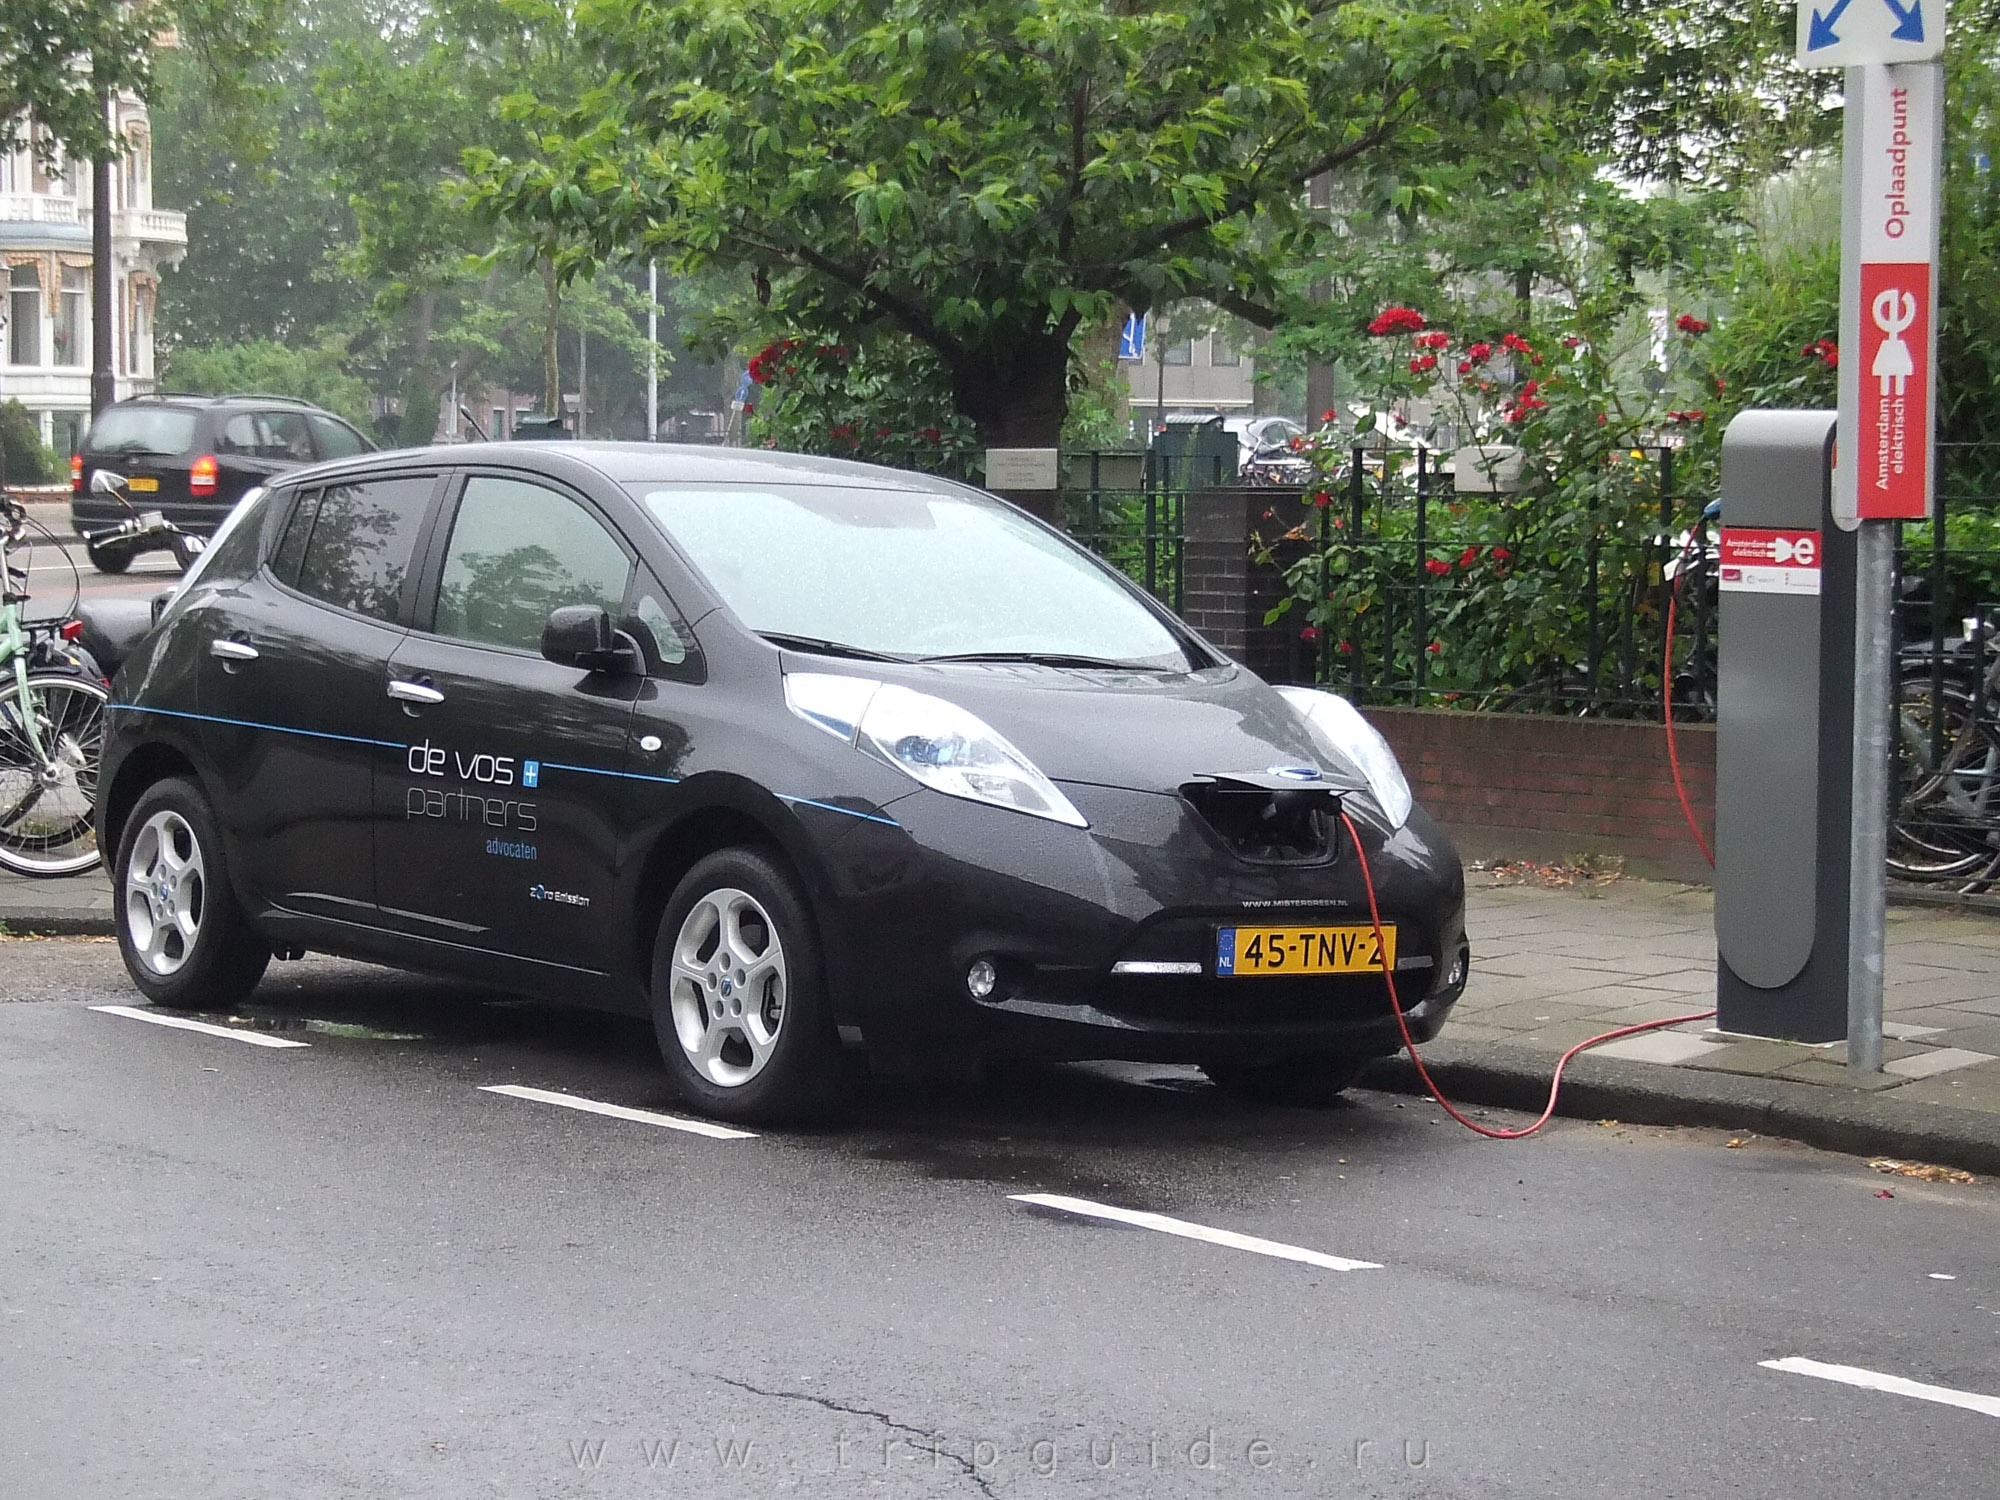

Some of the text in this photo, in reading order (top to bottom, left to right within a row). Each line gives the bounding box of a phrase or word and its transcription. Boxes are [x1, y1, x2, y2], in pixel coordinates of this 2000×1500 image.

[1884, 87, 1912, 239] Oplaadpunt
[1875, 398, 1890, 490] Amsterdam
[1890, 398, 1905, 474] elektrisch
[1726, 539, 1768, 548] Amsterdam
[408, 738, 446, 776] de
[455, 751, 515, 785] vos
[407, 787, 537, 831] partners
[486, 838, 537, 860] advocaten
[1219, 932, 1385, 968] NL 45-TNV-2
